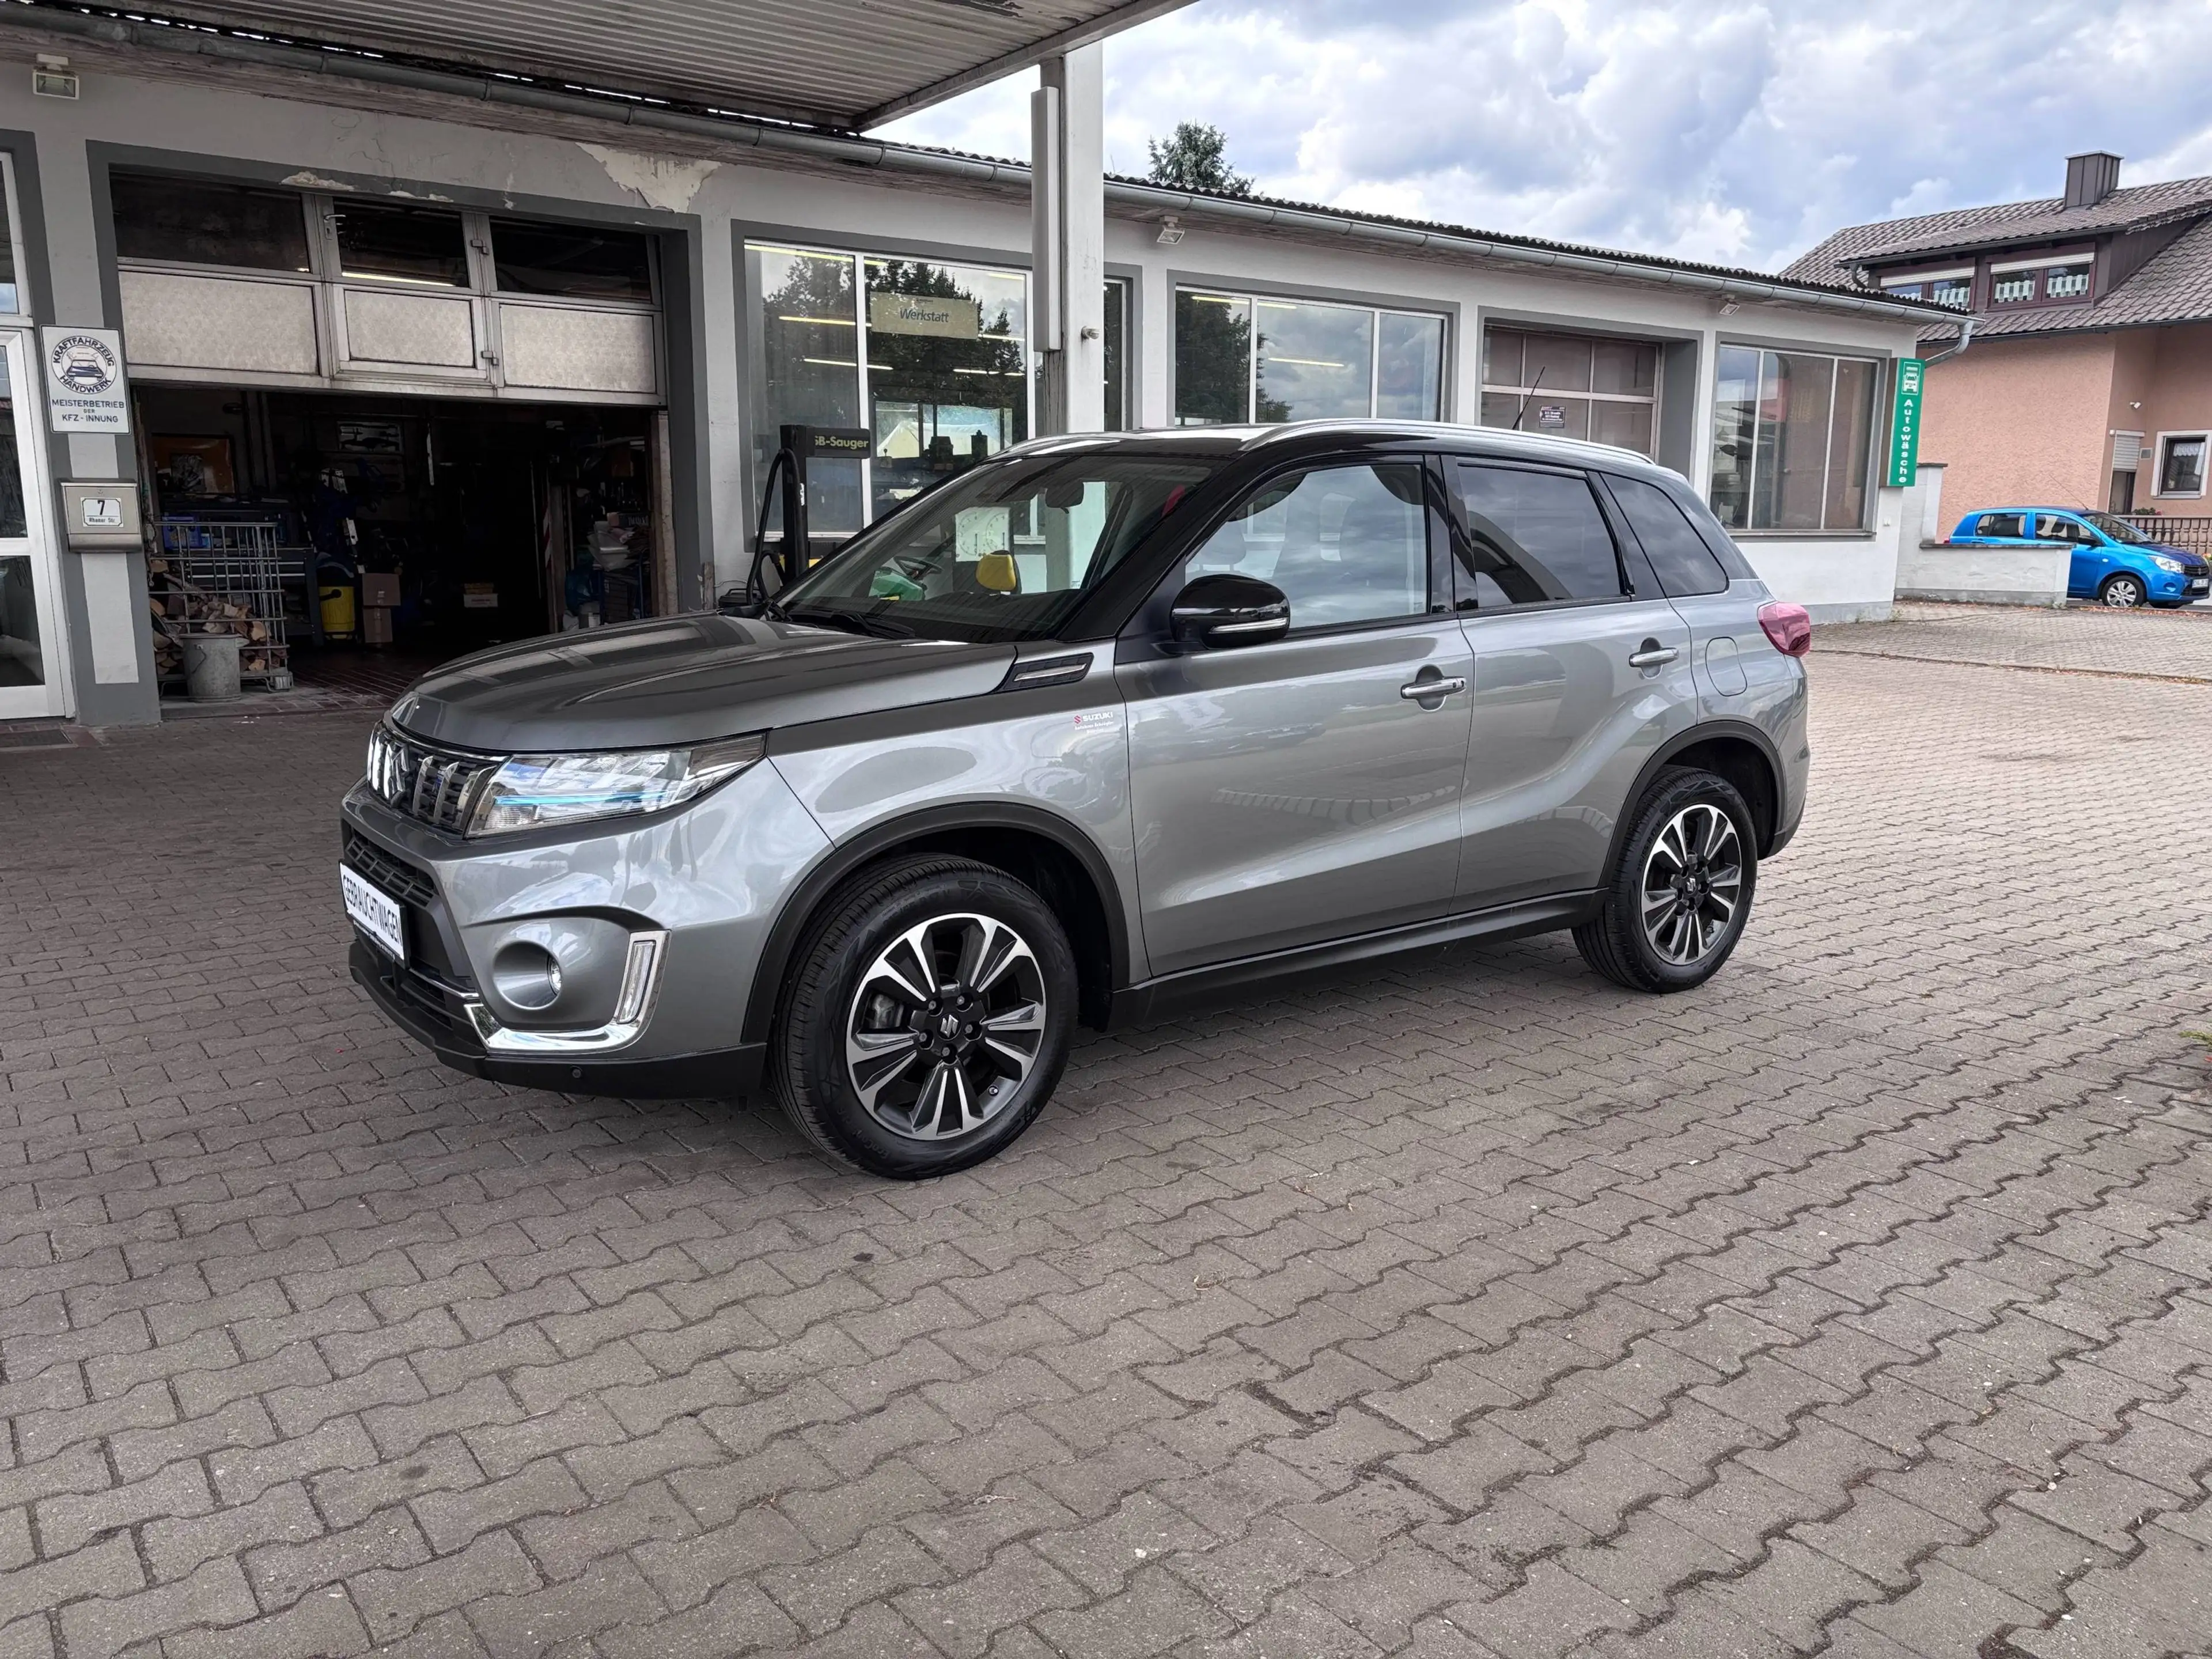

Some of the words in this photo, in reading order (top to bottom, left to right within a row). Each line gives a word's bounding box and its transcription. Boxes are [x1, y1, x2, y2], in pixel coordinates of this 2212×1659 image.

[900, 308, 949, 323] Werkstatt
[53, 337, 115, 367] KRAFTFAHRZEUG
[59, 375, 111, 393] HANDWERK
[52, 399, 125, 408] MEISTERBETRIEB
[1898, 399, 1914, 483] Autowäsche
[97, 499, 105, 516] 7
[1082, 711, 1113, 721] SUZUKI
[342, 874, 403, 947] GEBRAUCHTWAGEN
